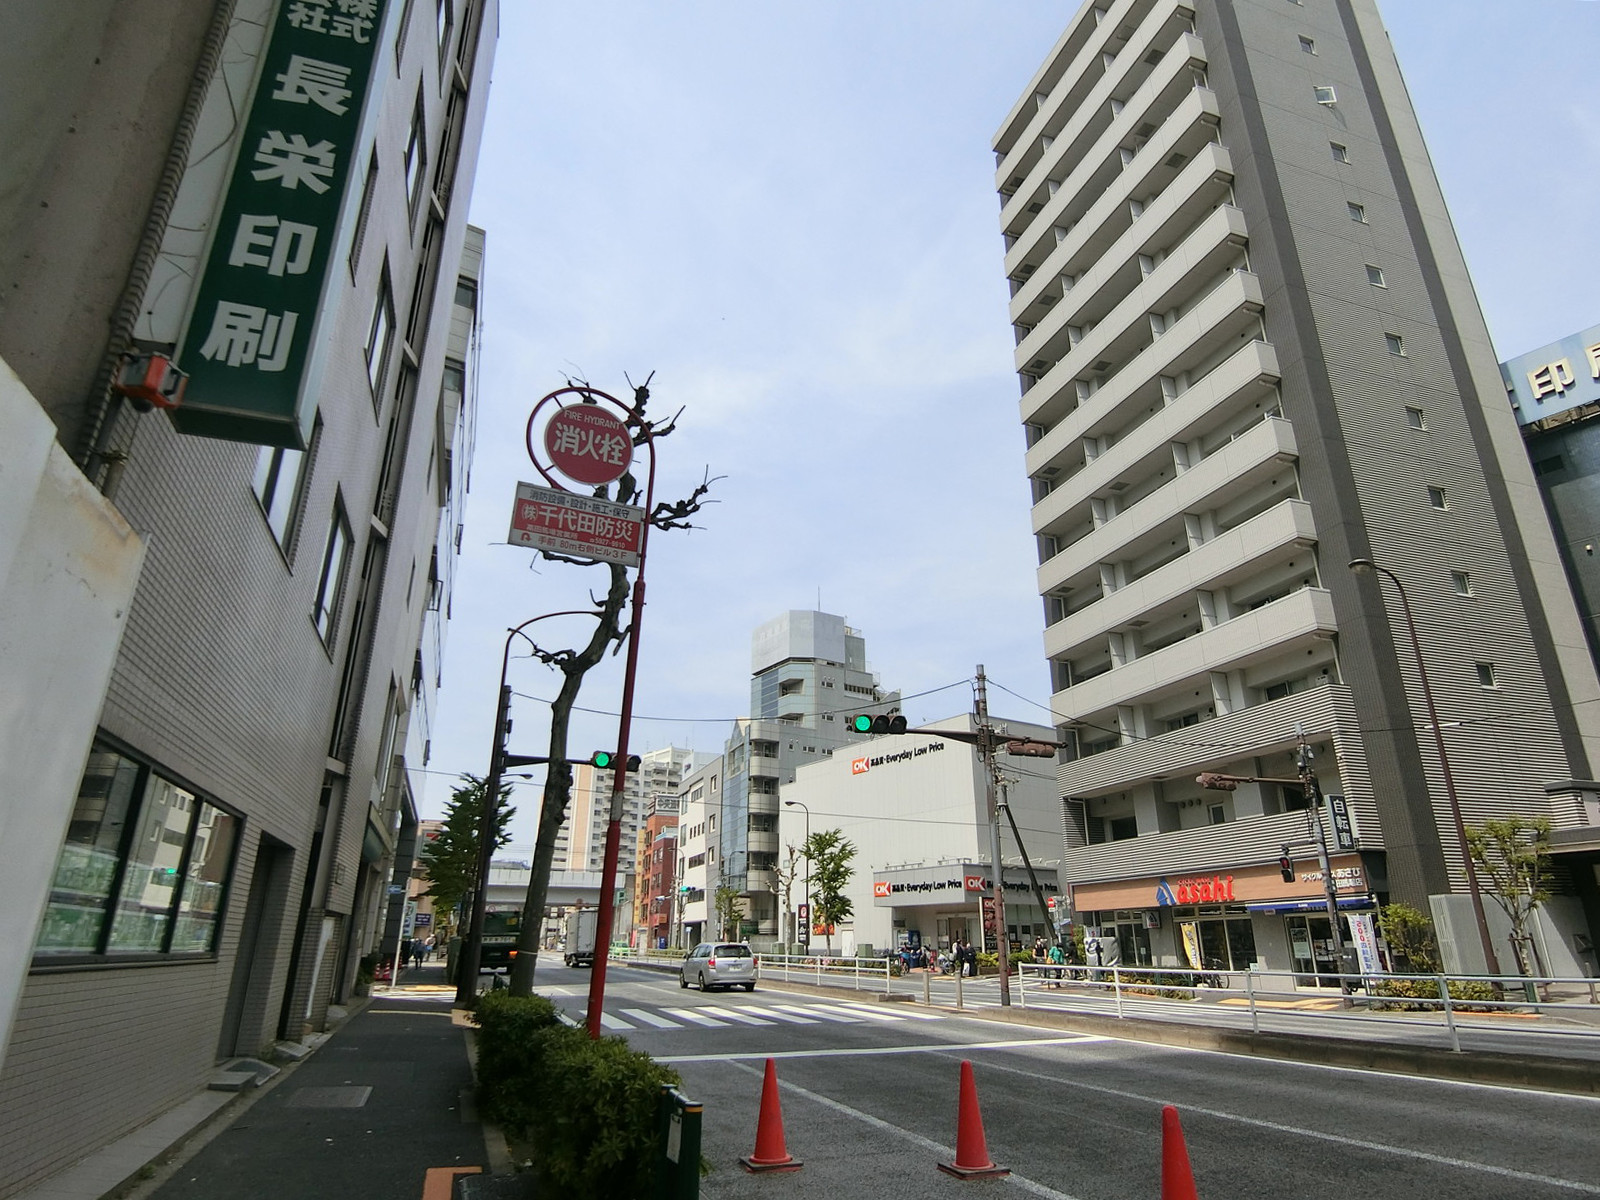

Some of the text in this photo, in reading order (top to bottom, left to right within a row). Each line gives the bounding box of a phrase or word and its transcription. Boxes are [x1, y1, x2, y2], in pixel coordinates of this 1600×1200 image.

[200, 54, 353, 373] 長栄印刷
[564, 410, 620, 430] FIRE HYDRANT
[552, 422, 627, 466] 消火栓
[853, 757, 869, 772] OK
[914, 747, 927, 757] Low
[928, 742, 944, 754] Price
[1332, 799, 1352, 847] 自転車
[875, 882, 890, 896] OK
[933, 880, 947, 891] Low
[947, 879, 962, 889] Price
[967, 876, 985, 891] OK
[1177, 875, 1235, 904] asahi
